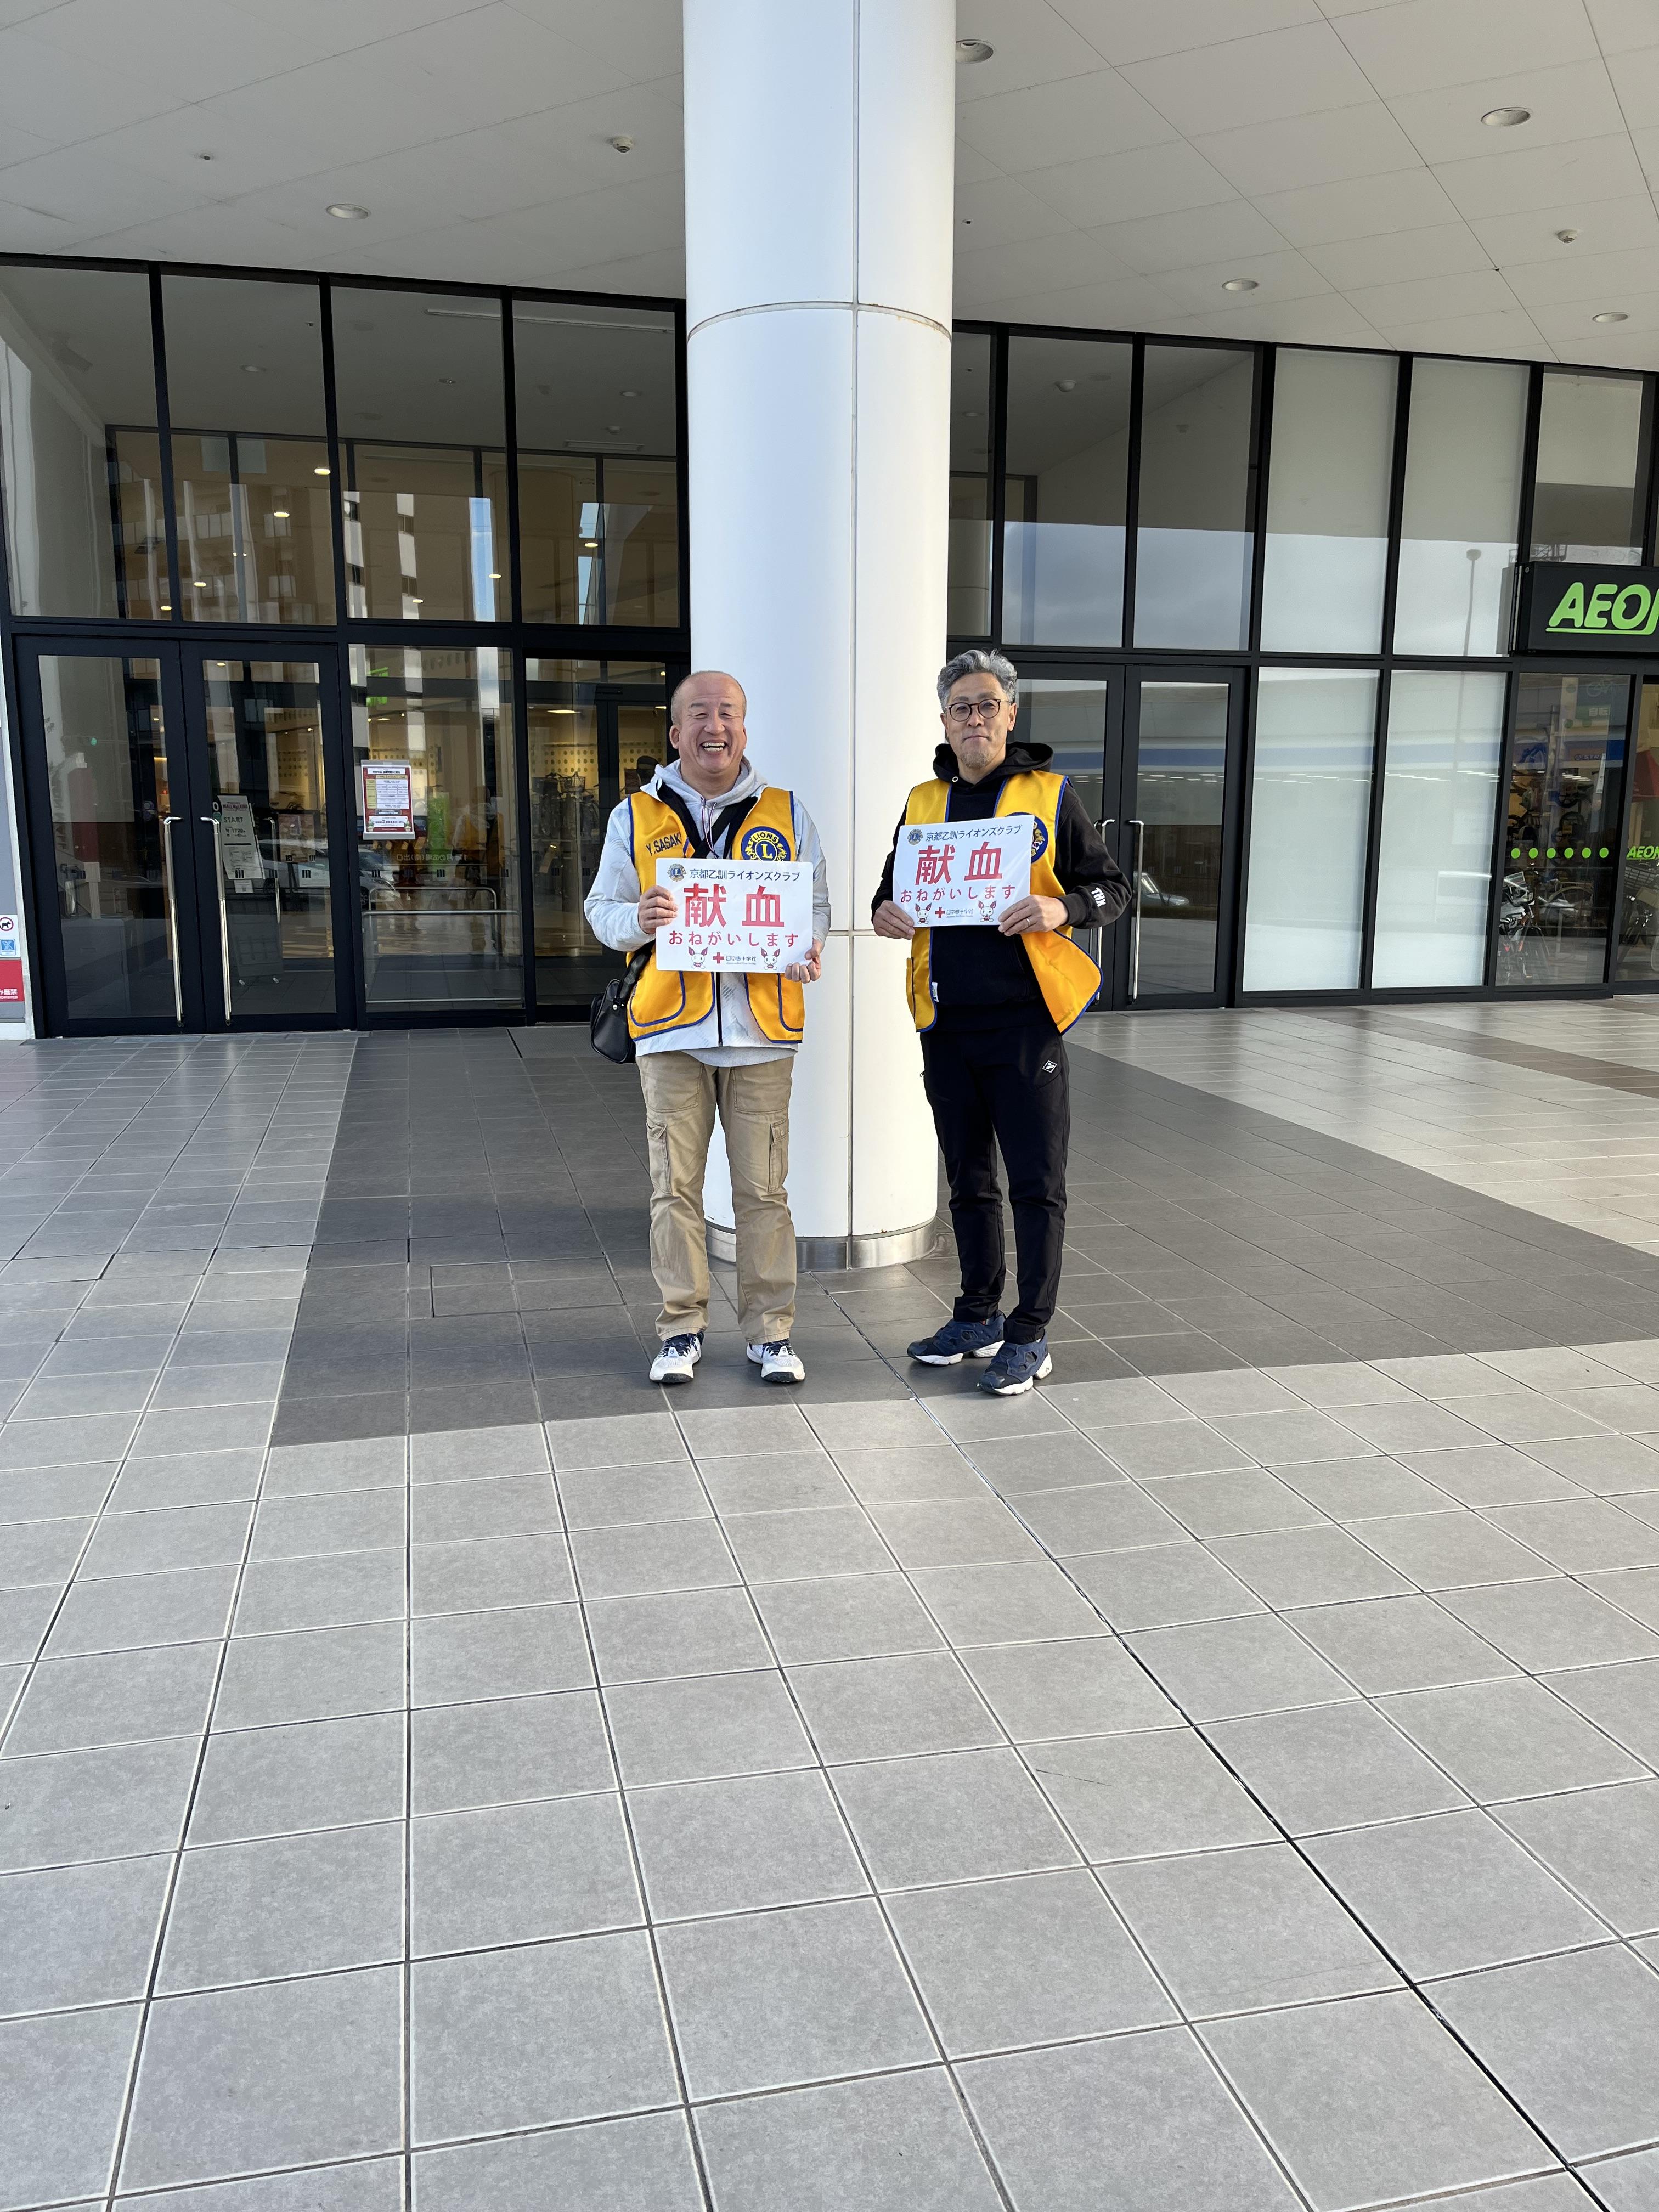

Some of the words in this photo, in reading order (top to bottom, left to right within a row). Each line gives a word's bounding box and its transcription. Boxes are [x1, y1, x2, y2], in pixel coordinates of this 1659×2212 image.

[753, 832, 778, 843] LIONS
[926, 825, 1022, 842] 京都乙訓ライオンズクラブ
[761, 844, 773, 859] L
[916, 842, 1002, 885] 献血
[690, 868, 801, 883] 京都乙訓ライオンズクラブ
[901, 885, 1015, 903] おねがいします
[1091, 887, 1106, 907] THX
[684, 883, 785, 928] 献血
[669, 930, 799, 948] おねがいします
